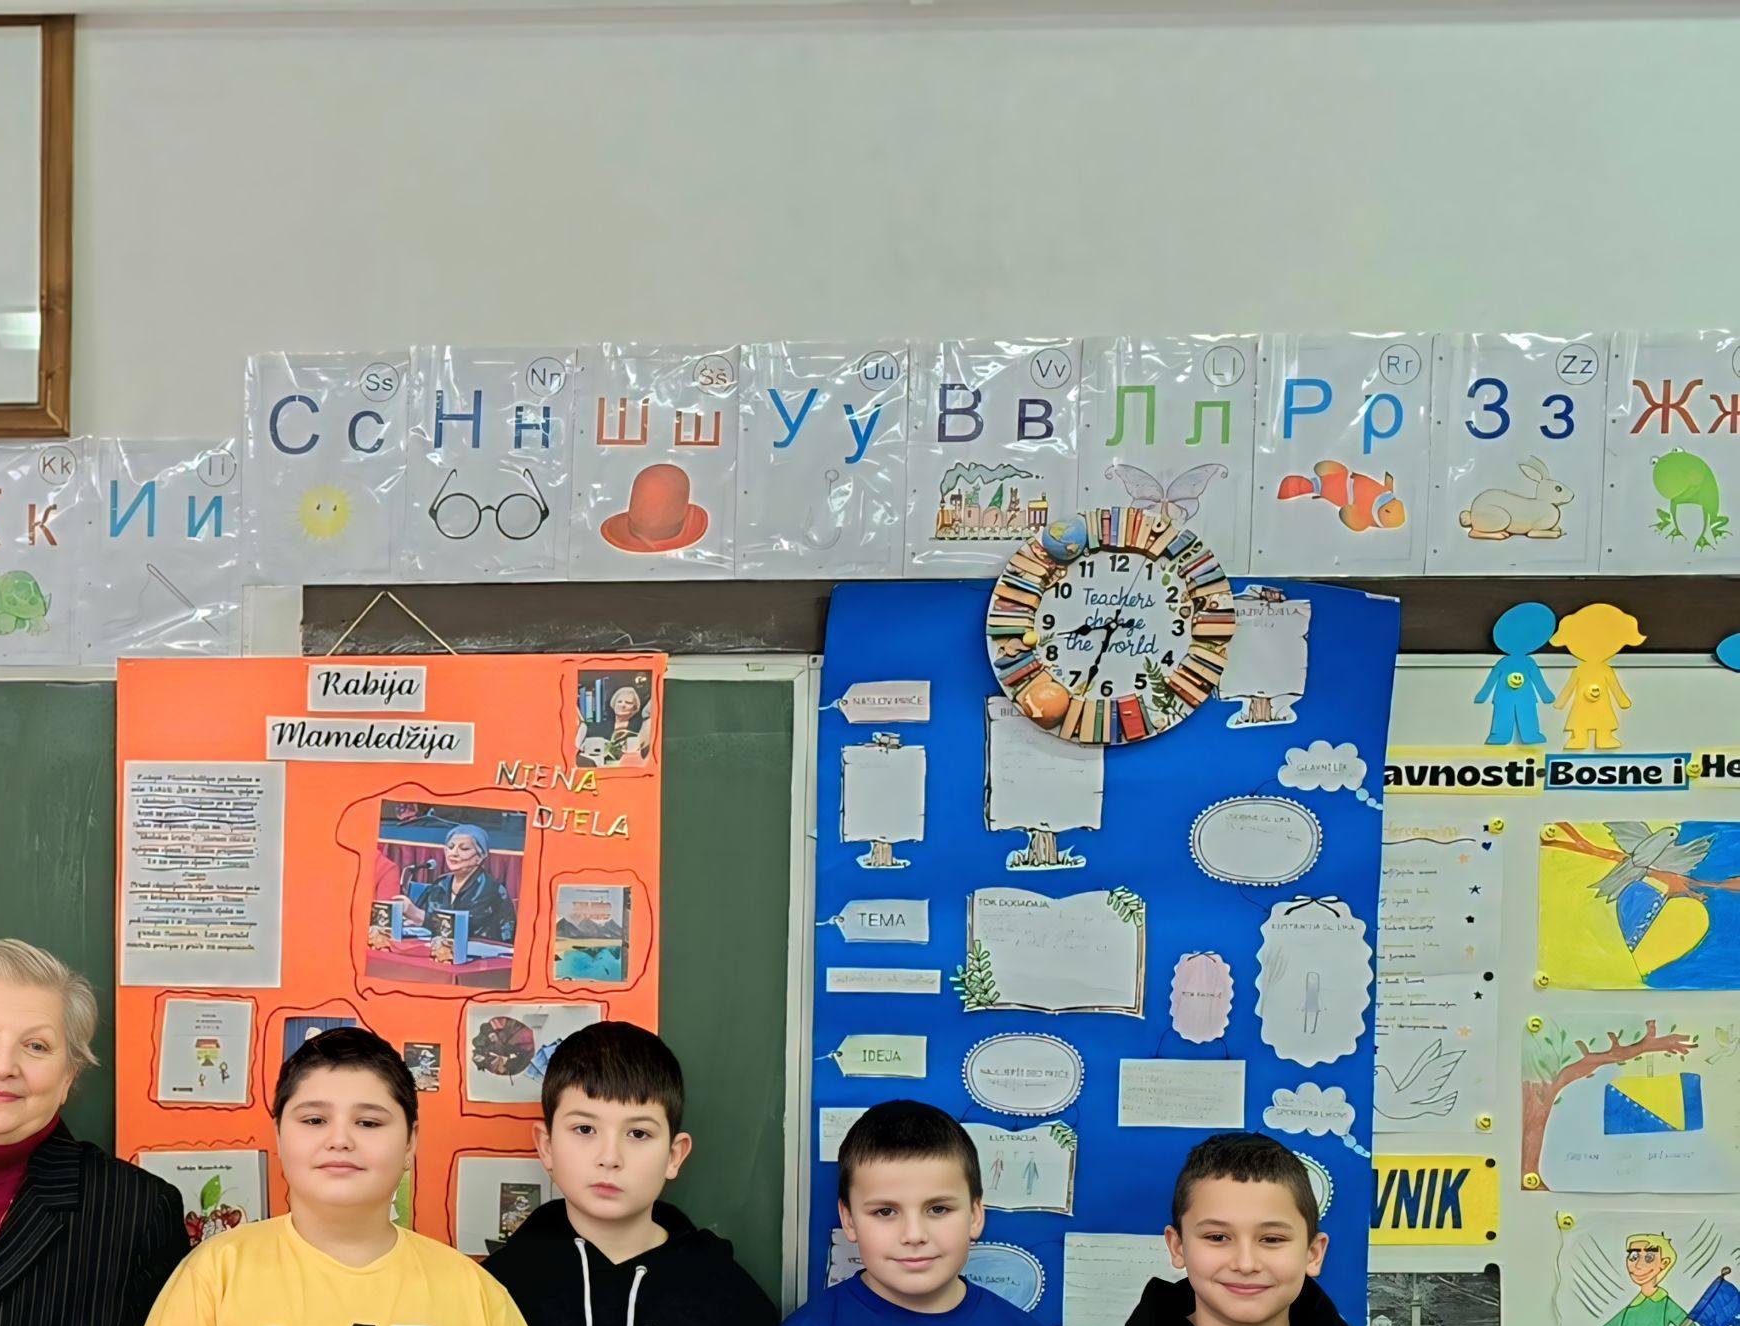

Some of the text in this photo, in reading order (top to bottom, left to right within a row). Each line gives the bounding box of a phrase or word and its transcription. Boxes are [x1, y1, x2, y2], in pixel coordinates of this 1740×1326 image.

[1079, 561, 1095, 578] 11
[1109, 555, 1130, 572] 12
[1145, 563, 1153, 580] 1
[1054, 583, 1072, 599] 10
[1083, 586, 1156, 609] Teachers
[1166, 586, 1178, 604] 2
[1042, 614, 1055, 630] 9
[1171, 620, 1185, 637] 3
[1066, 632, 1094, 652] the
[1045, 645, 1058, 662] 8
[1161, 650, 1174, 667] 4
[317, 669, 421, 706] Rabija
[1069, 671, 1082, 688] 7
[1134, 674, 1147, 690] 5
[1100, 680, 1113, 697] 6
[272, 721, 461, 760] Mameledžija
[495, 760, 599, 795] NJENA
[1549, 760, 1663, 786] Bosne
[1672, 757, 1685, 786] i
[532, 805, 630, 839] DJELA
[857, 912, 906, 928] TEMA
[861, 1048, 903, 1064] IDEJA
